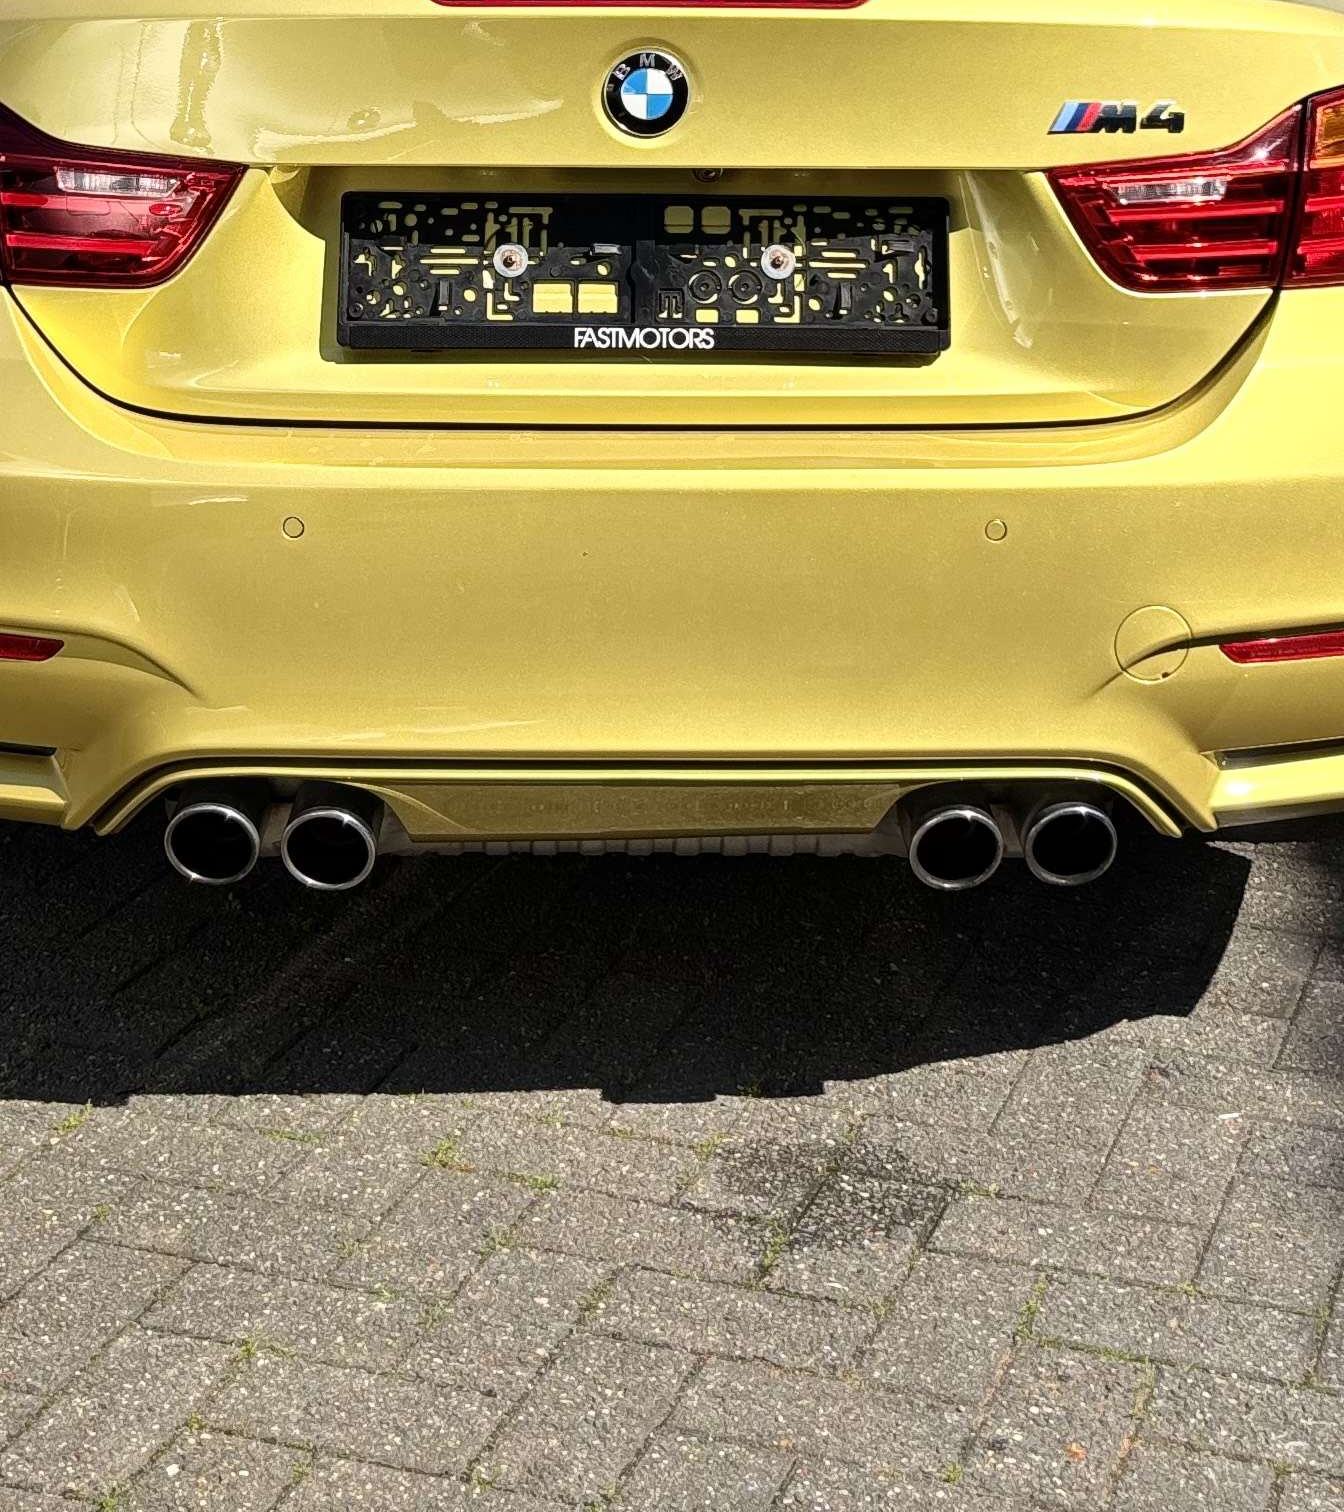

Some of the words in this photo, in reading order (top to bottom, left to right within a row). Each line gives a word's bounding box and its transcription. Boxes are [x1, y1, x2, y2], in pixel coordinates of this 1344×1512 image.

[613, 53, 683, 81] BMW
[1066, 99, 1185, 135] M4
[574, 327, 715, 350] FASTMOTORS
